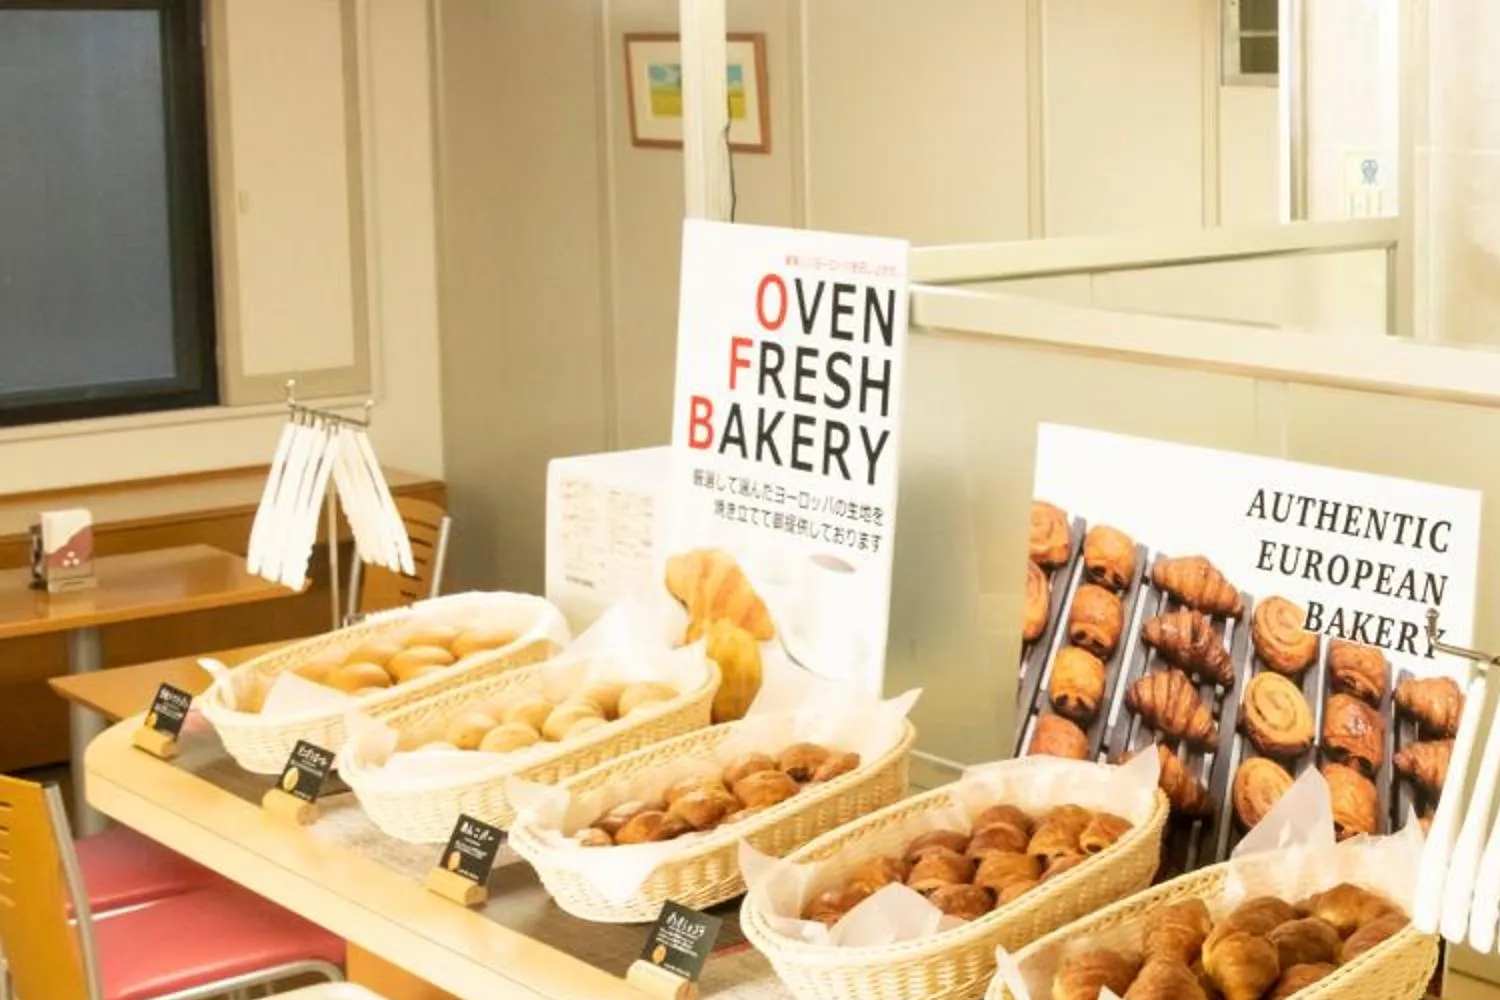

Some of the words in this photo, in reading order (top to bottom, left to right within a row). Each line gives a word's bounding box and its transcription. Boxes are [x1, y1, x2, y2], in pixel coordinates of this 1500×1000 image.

[755, 273, 896, 347] OVEN
[729, 336, 891, 417] FRESH
[687, 395, 891, 486] BAKERY
[1246, 487, 1453, 554] AUTHENTIC
[1256, 539, 1449, 606] EUROPEAN
[1303, 600, 1446, 659] BAKERY
